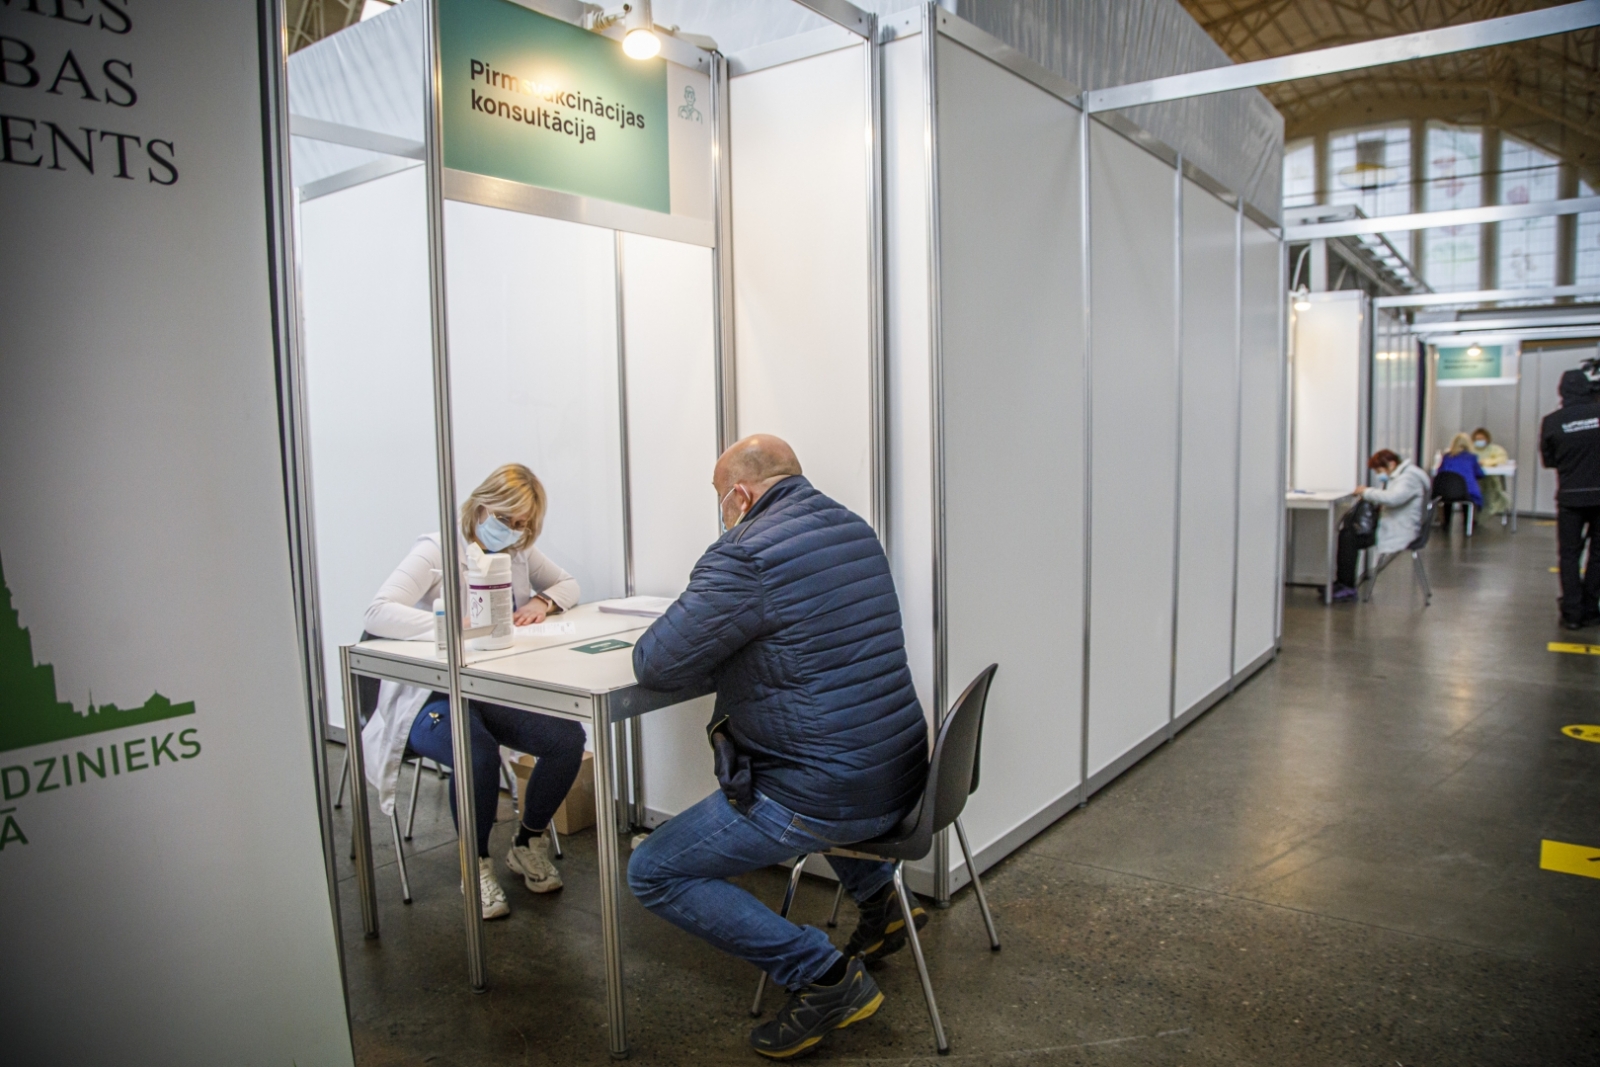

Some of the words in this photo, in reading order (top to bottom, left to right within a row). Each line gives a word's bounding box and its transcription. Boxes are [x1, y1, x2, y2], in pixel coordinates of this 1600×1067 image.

[0, 35, 138, 107] BAS
[0, 114, 179, 186] ENTS
[471, 88, 596, 144] konsultācija
[1, 728, 202, 800] DZINIEKS
